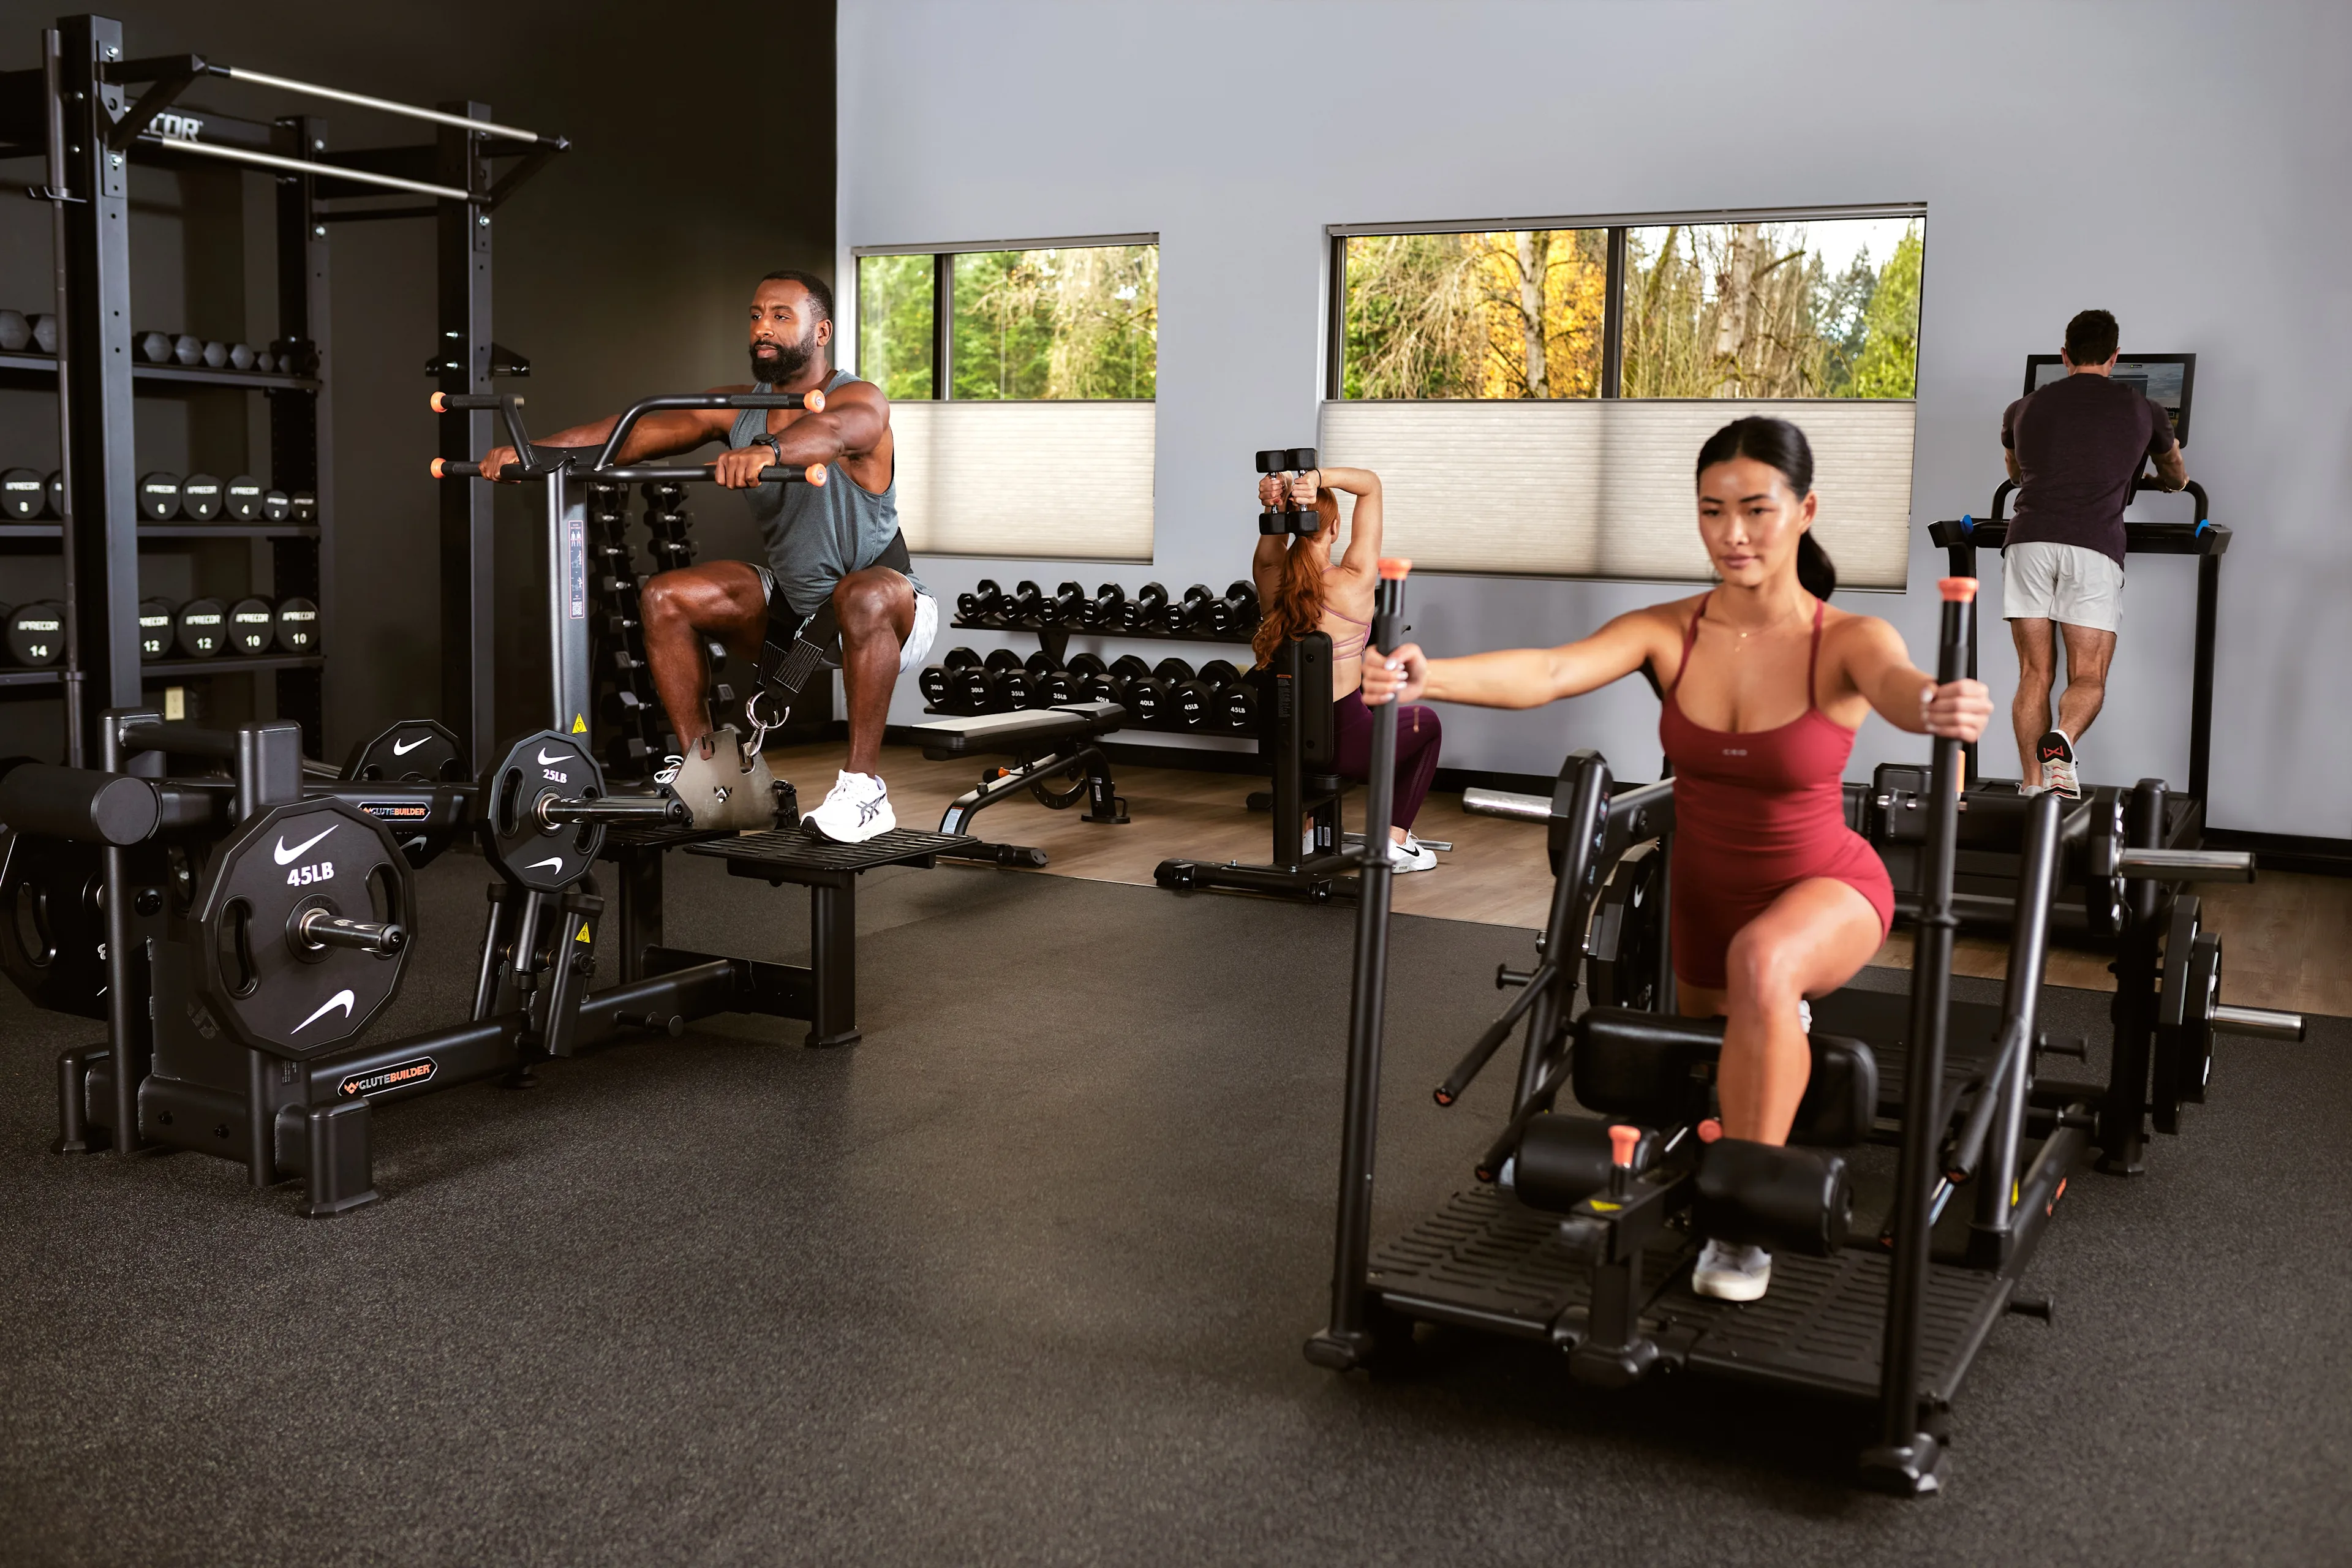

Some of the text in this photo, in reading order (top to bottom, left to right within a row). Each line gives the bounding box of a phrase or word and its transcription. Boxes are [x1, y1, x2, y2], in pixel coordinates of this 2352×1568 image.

[157, 503, 165, 514] 6
[199, 504, 207, 514] 4
[241, 505, 249, 514] 4
[197, 638, 212, 649] 12
[246, 635, 260, 646] 10
[293, 633, 307, 644] 10
[29, 645, 48, 657] 14
[144, 640, 160, 652] 12
[543, 769, 567, 783] 25LB
[287, 861, 334, 886] 45LB
[359, 1064, 430, 1090] GLUTEBUILDER
